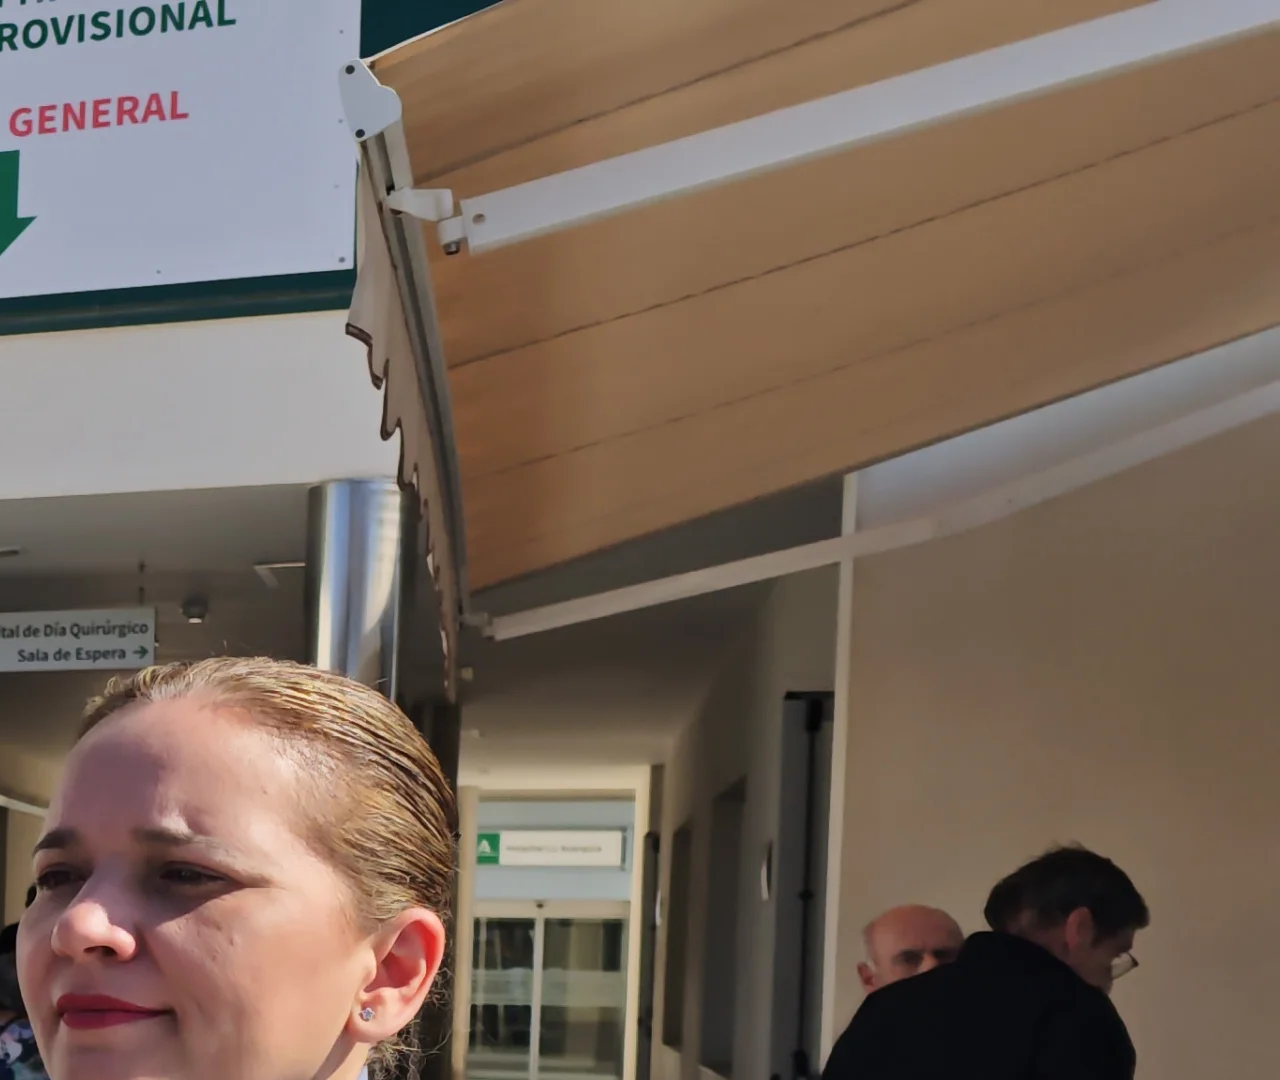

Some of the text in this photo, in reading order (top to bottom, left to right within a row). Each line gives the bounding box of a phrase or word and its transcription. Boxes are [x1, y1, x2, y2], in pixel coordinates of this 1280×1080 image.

[8, 91, 189, 137] GENERAL
[23, 626, 39, 638] de
[43, 621, 67, 637] Día
[70, 619, 149, 640] Quirúrgico
[17, 646, 126, 663] Sala de Espera
